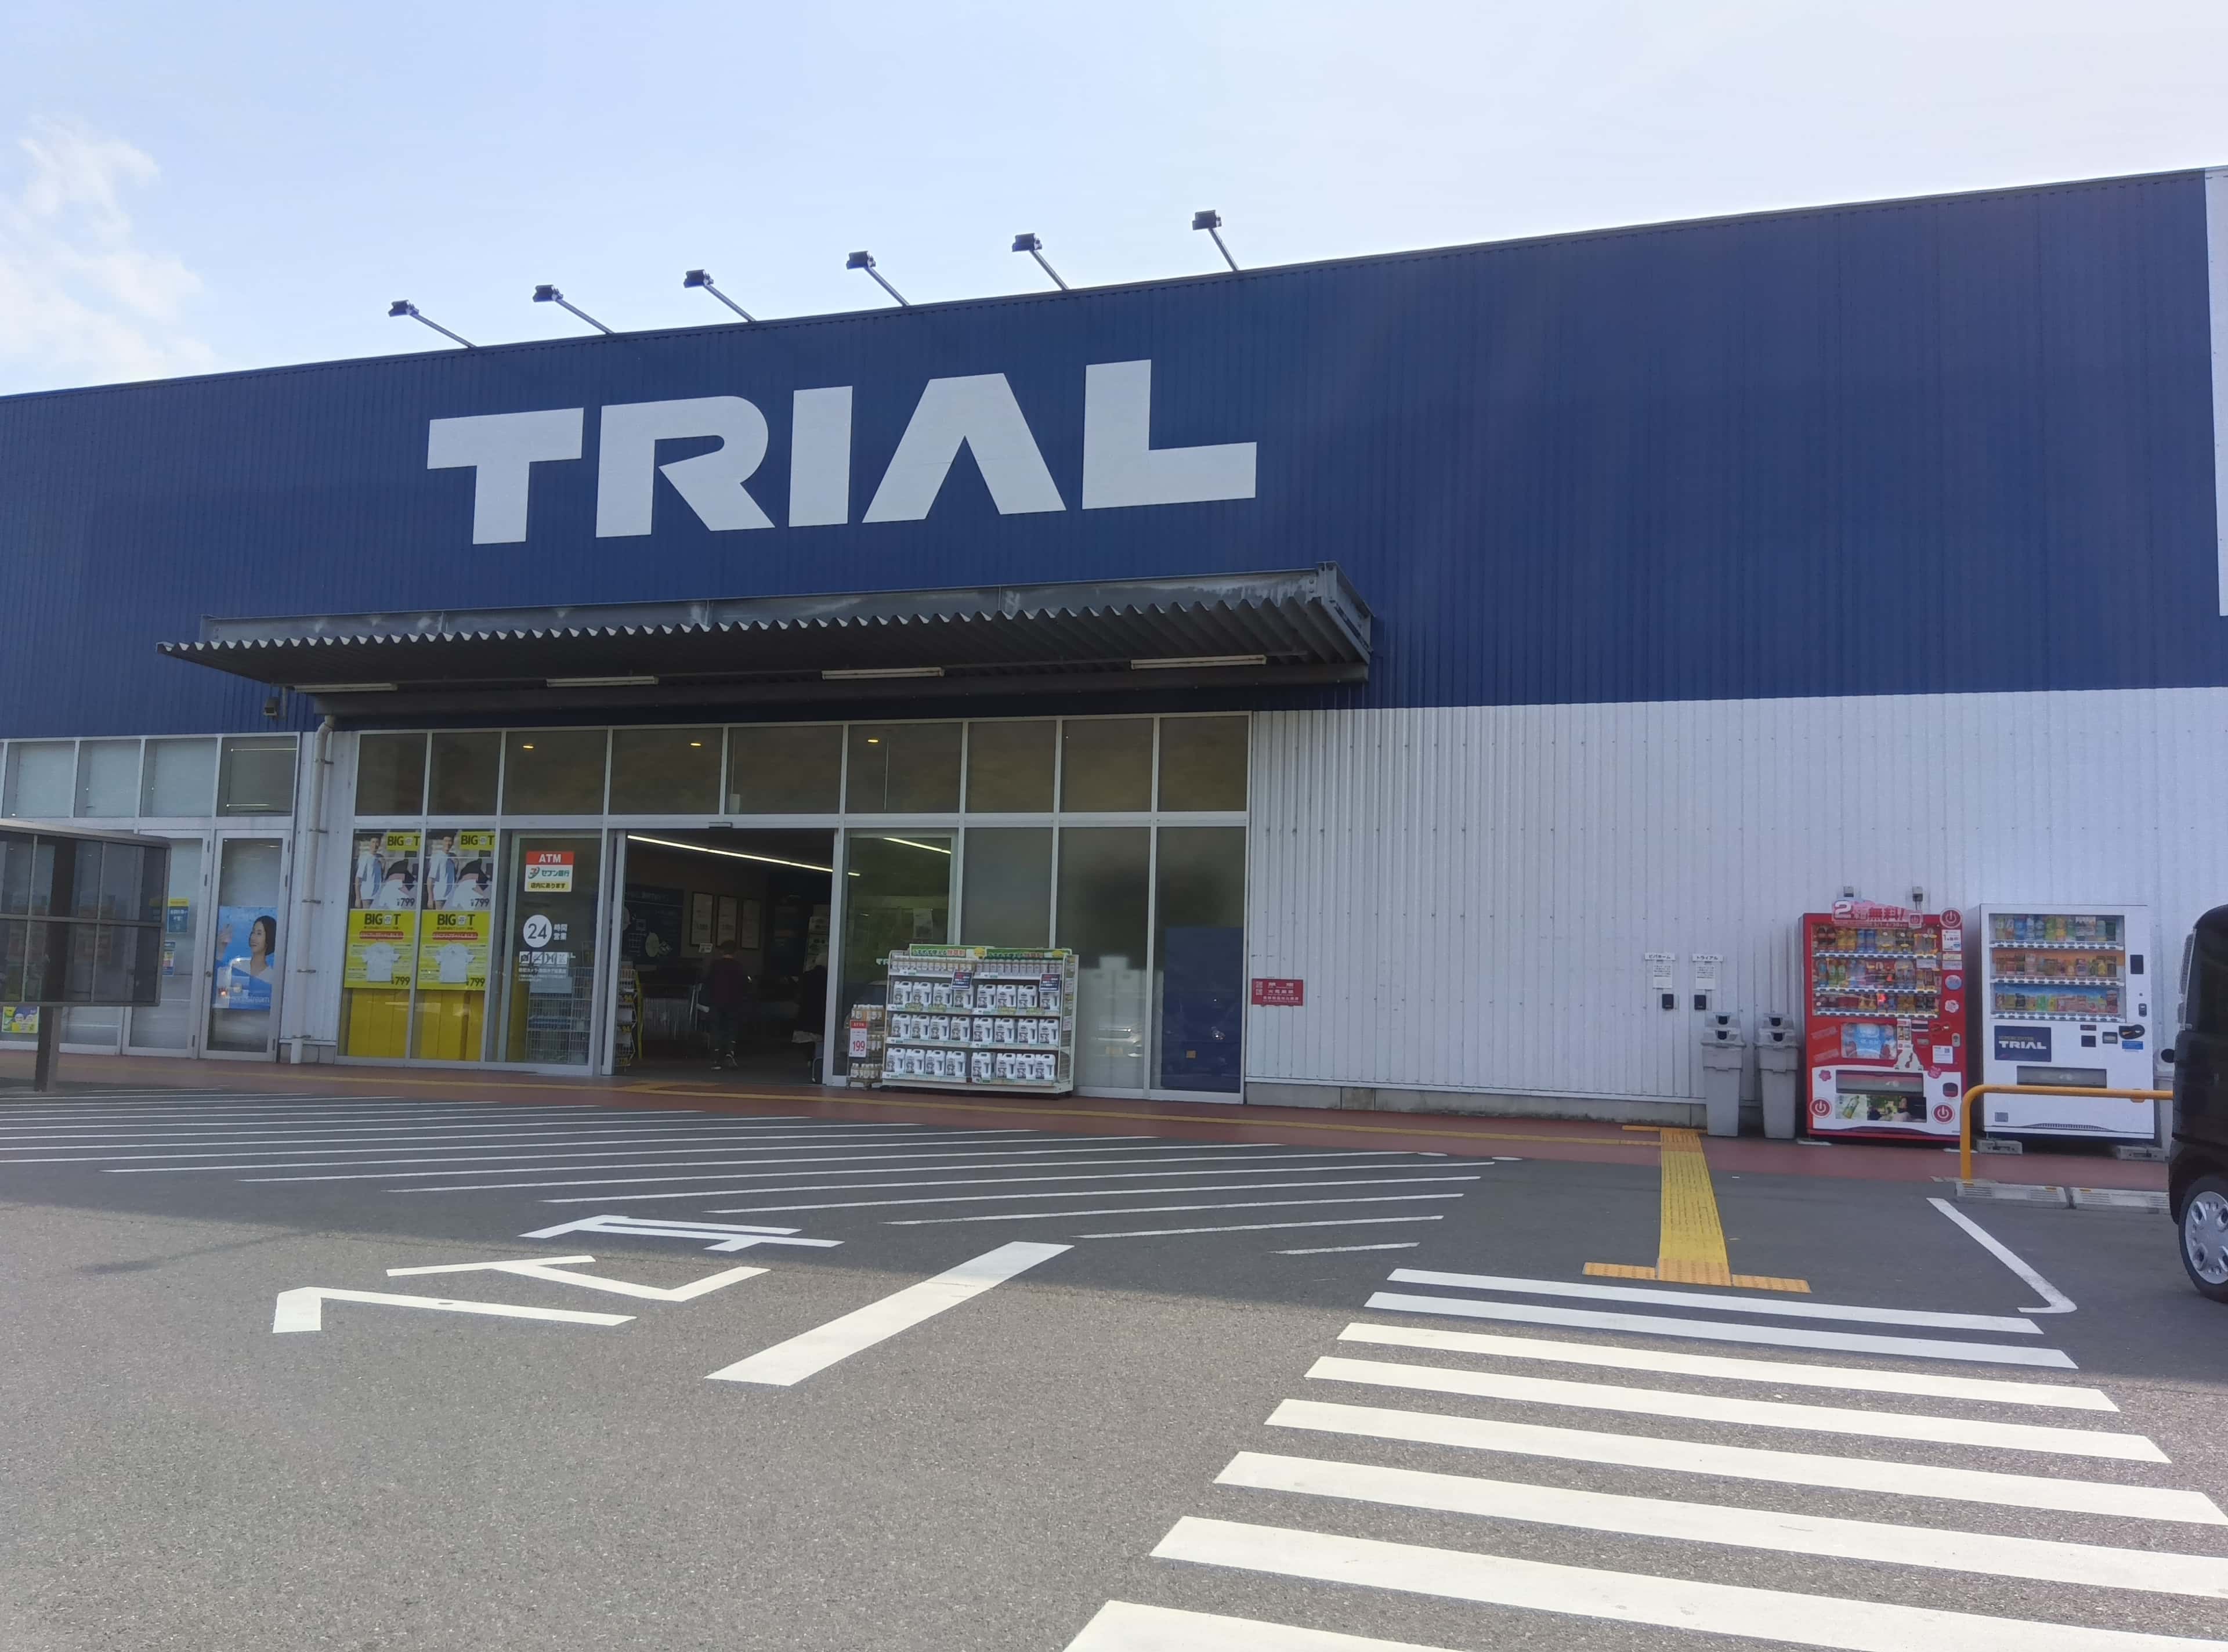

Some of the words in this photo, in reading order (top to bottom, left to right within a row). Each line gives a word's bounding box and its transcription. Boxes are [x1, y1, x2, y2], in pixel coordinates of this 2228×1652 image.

[427, 359, 1257, 544] TRIAL
[388, 836, 404, 846] BIG
[461, 835, 478, 845] BIG
[538, 854, 562, 863] ATM
[400, 898, 415, 906] 799
[475, 898, 490, 907] 799
[364, 913, 383, 925] BIG
[437, 914, 457, 926] BIG
[527, 923, 547, 939] 24
[395, 976, 410, 986] 799
[469, 977, 485, 987] 799
[852, 1040, 866, 1051] 199
[1999, 1040, 2047, 1049] TRIAL
